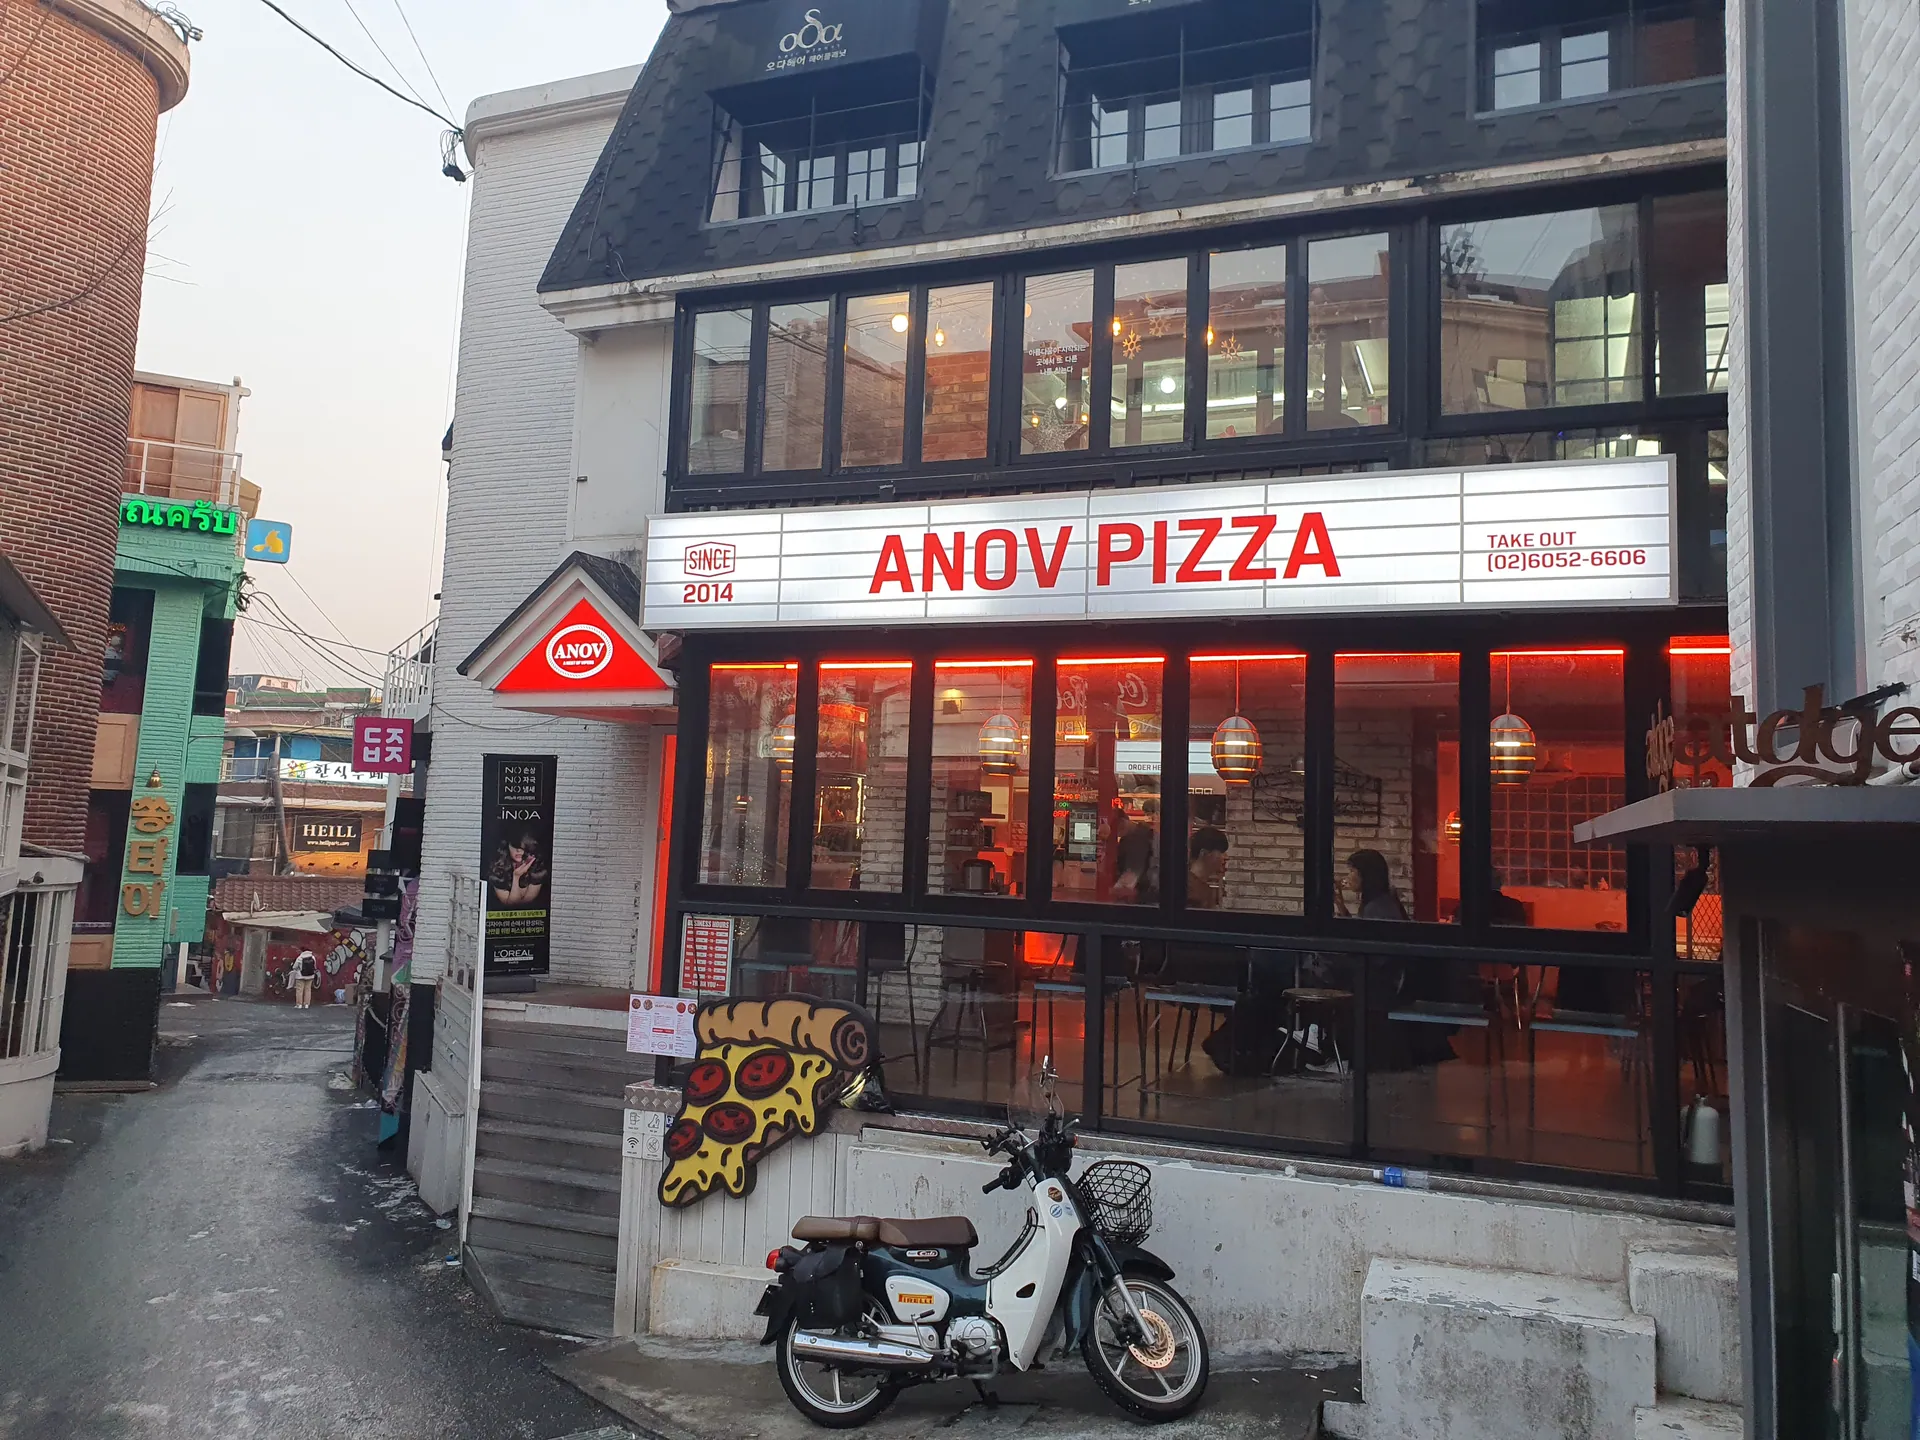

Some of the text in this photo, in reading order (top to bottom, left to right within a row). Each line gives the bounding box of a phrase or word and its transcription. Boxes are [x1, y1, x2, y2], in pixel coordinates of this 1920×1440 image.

[1487, 531, 1577, 549] TAKE OUT
[688, 547, 732, 571] SINCE
[869, 511, 1342, 594] ANOV PIZZA
[1487, 549, 1647, 572] (02)6052-6606
[683, 582, 733, 604] 2014
[553, 642, 605, 659] ANOV
[1128, 763, 1151, 771] ORDER
[302, 824, 357, 838] HEILL
